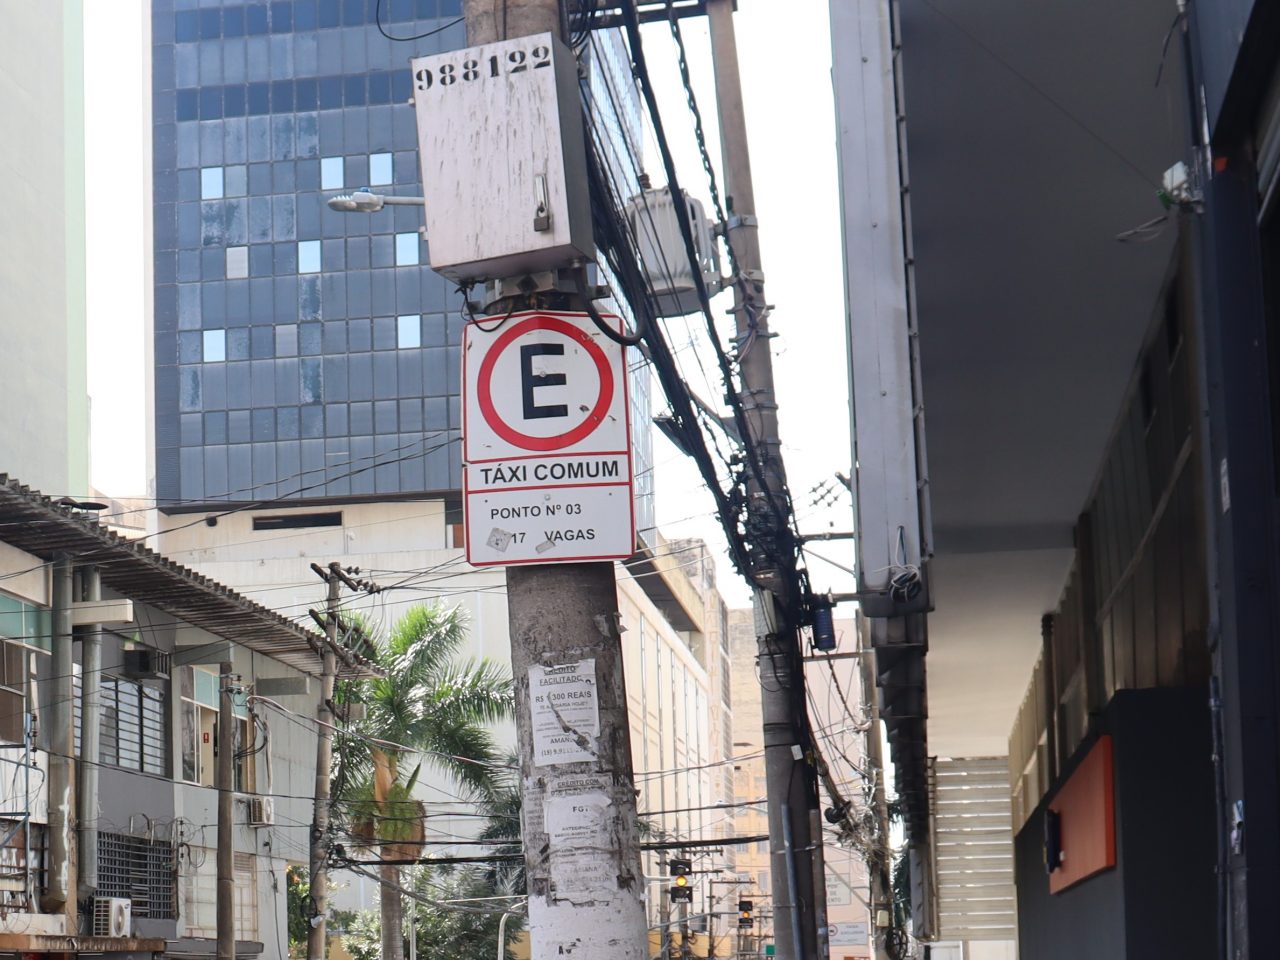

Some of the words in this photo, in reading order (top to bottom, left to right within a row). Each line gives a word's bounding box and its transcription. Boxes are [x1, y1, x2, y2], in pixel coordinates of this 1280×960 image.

[416, 46, 551, 91] 988122
[520, 344, 568, 420] E
[480, 463, 527, 485] TÁXI
[534, 460, 619, 481] COMUM
[491, 505, 541, 519] PONTO
[566, 503, 582, 515] 03
[511, 532, 526, 544] 17
[545, 529, 595, 542] VAGAS
